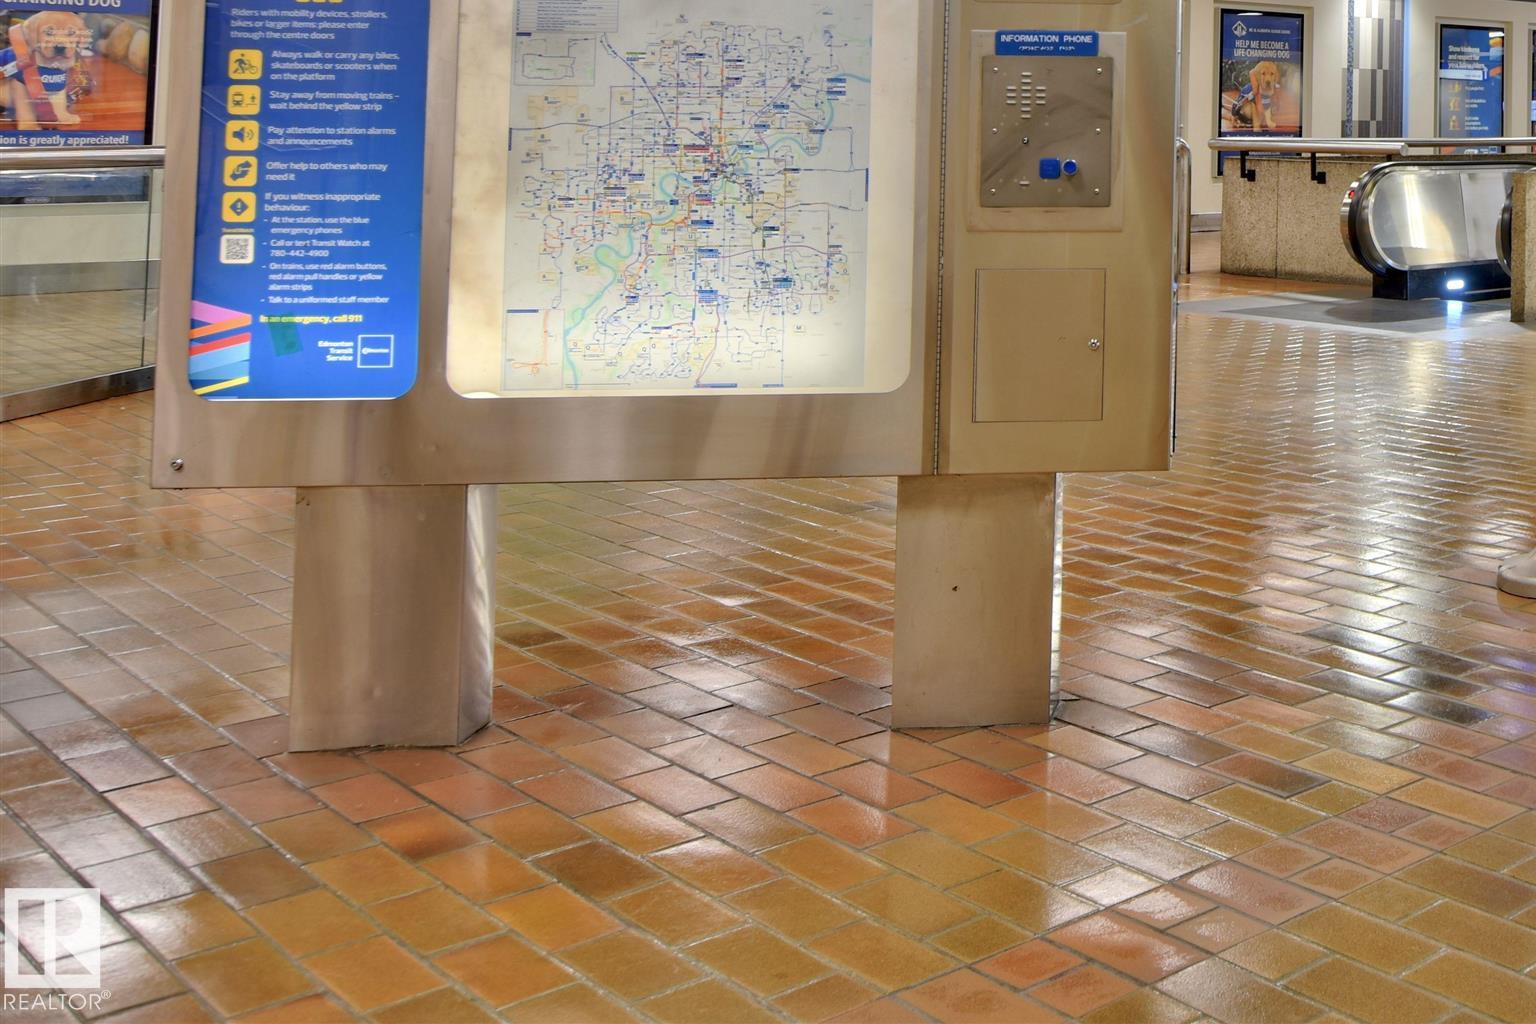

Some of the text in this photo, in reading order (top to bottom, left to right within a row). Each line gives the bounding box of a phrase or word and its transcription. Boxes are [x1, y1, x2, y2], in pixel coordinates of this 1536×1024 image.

[1000, 34, 1093, 43] INFORMATION PHONE
[334, 63, 372, 71] scooters
[269, 90, 394, 101] Stay away from moving trains
[268, 102, 383, 112] wait behind the yellow strip
[267, 126, 285, 135] Pay
[285, 126, 325, 134] attention
[336, 127, 366, 135] station
[367, 127, 396, 135] alarms
[20, 135, 28, 144] is
[29, 136, 65, 146] greatly
[67, 136, 129, 147] appreciated!
[266, 137, 353, 146] and announcements
[265, 161, 388, 172] Offer help to others who may
[265, 173, 288, 181] need
[272, 193, 289, 202] you
[290, 193, 324, 201] witness
[325, 193, 381, 202] inappropriate
